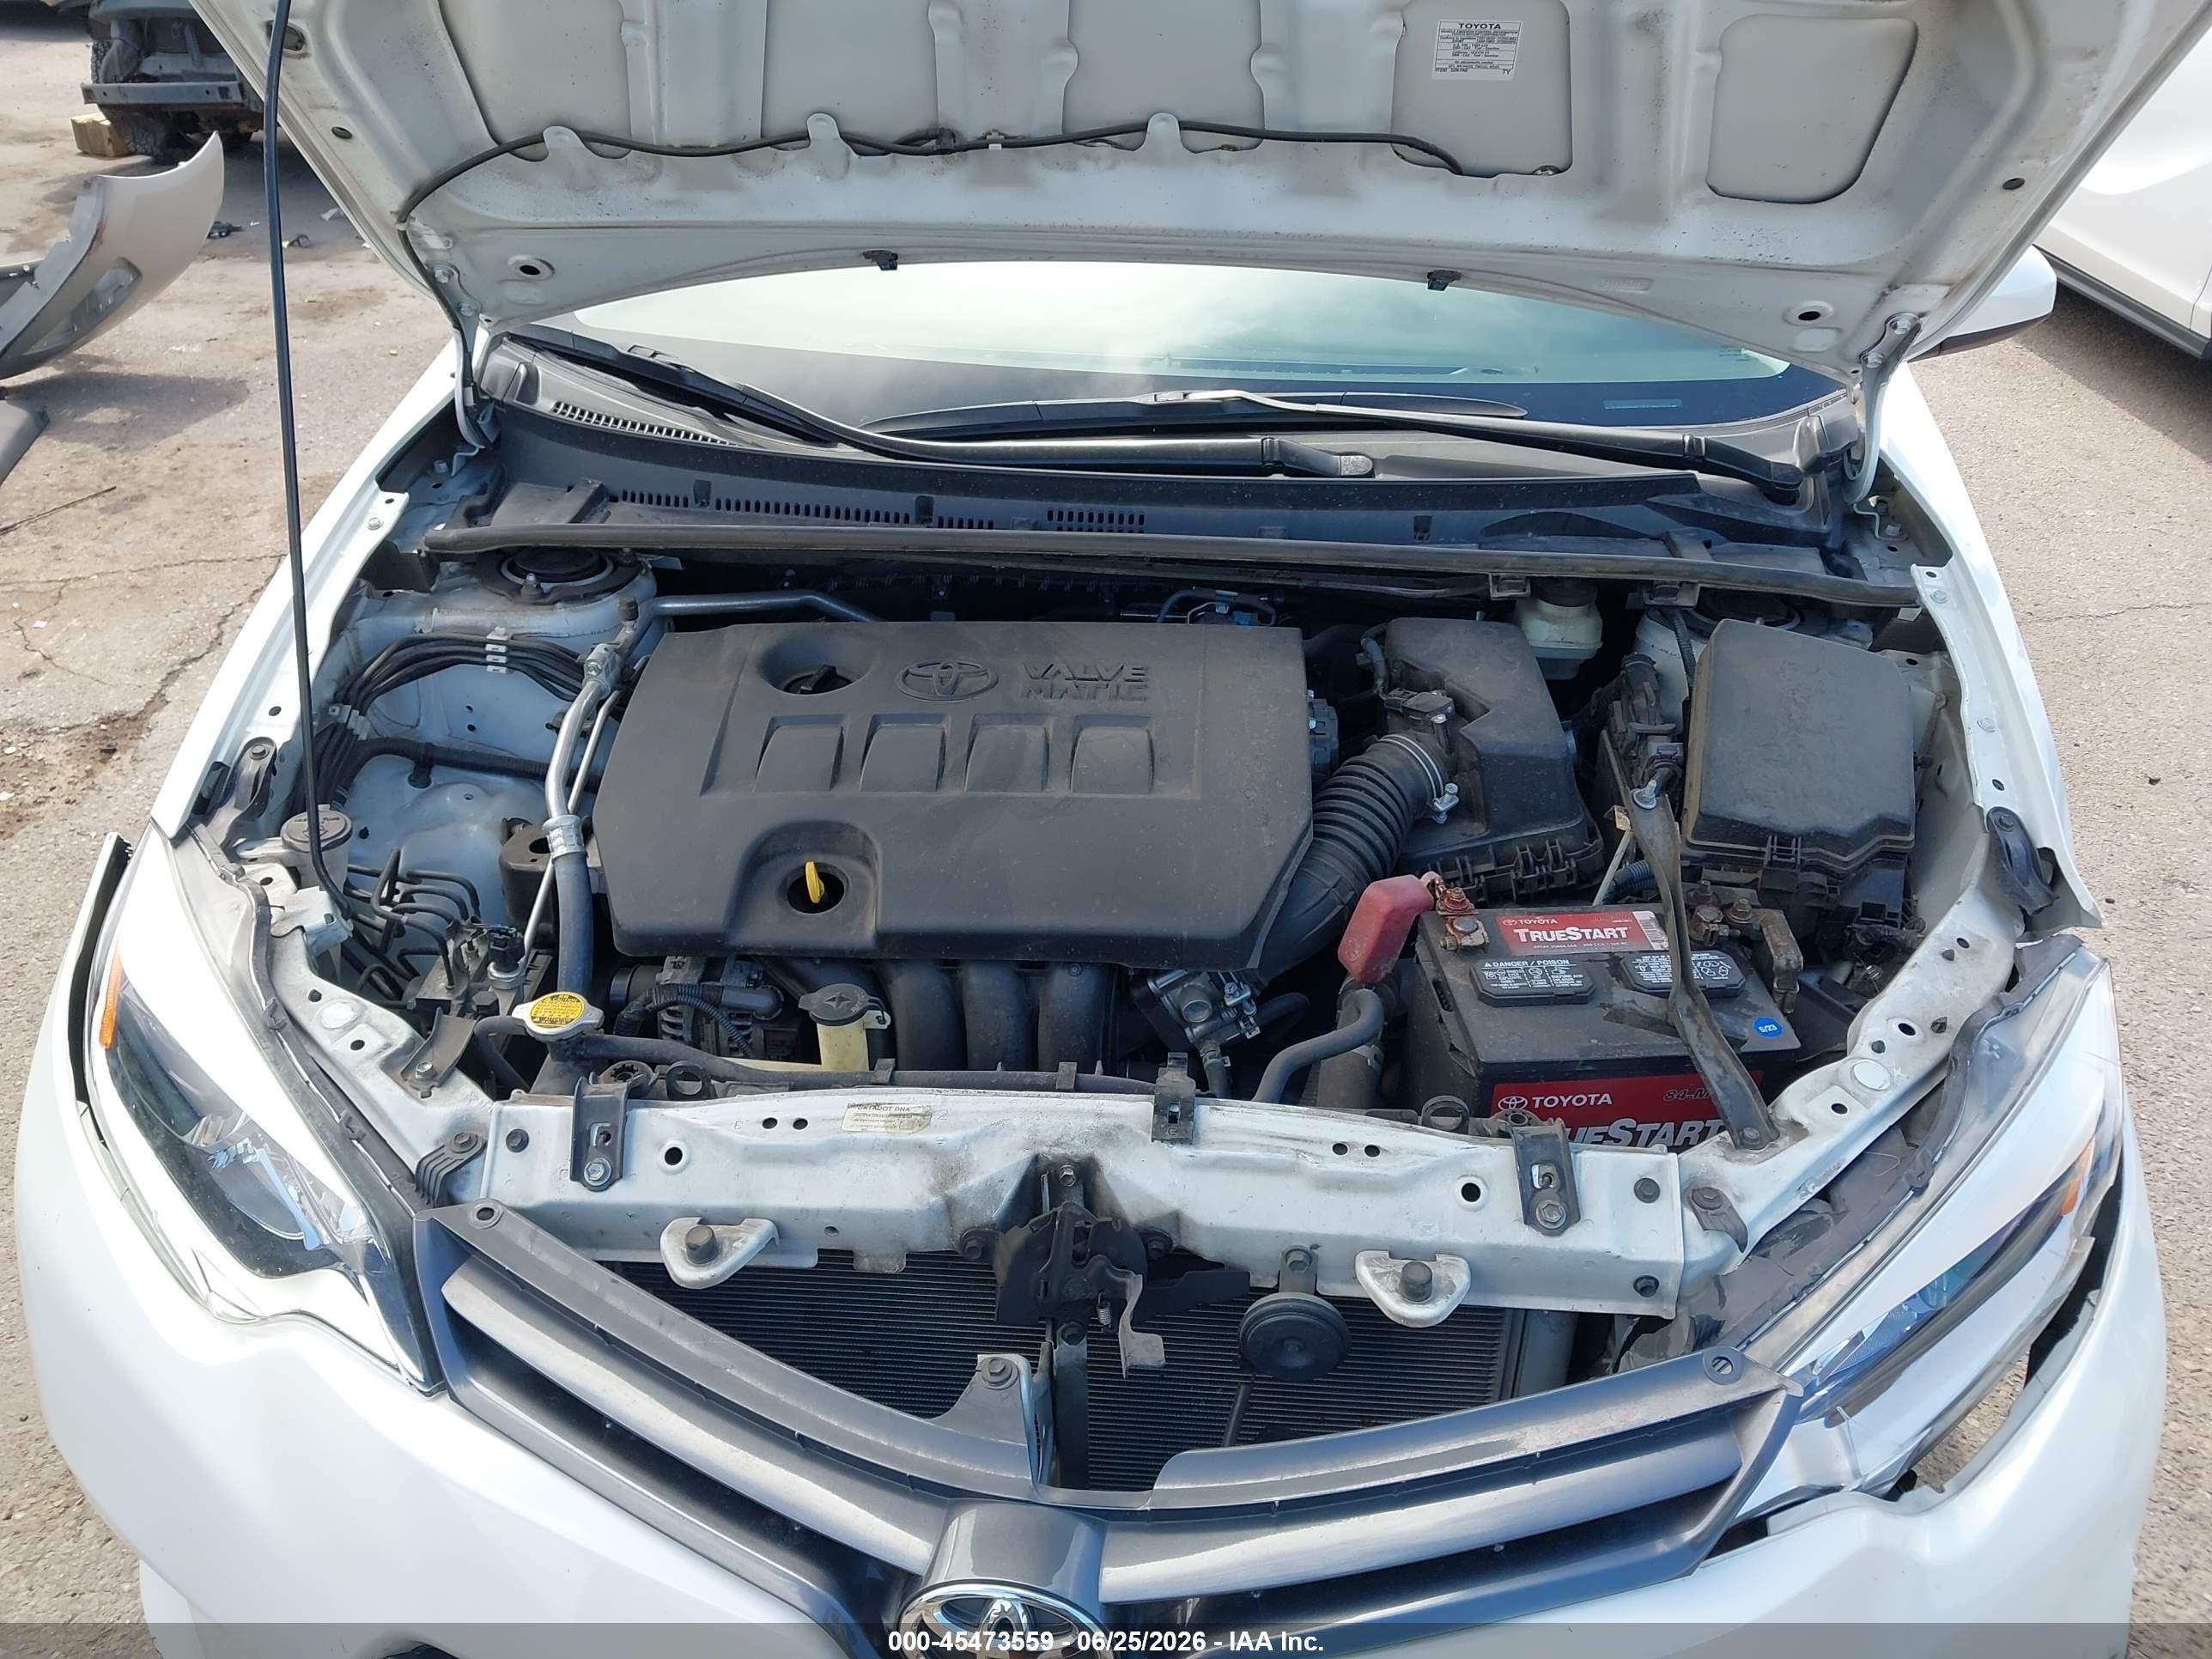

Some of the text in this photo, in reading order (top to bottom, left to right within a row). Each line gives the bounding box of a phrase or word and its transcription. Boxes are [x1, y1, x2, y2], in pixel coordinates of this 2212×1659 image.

[1022, 662, 1149, 682] VALVE
[1018, 684, 1148, 701] MATIC
[1758, 1024, 1778, 1033] 5/23
[1532, 1093, 1613, 1109] TOYOTA
